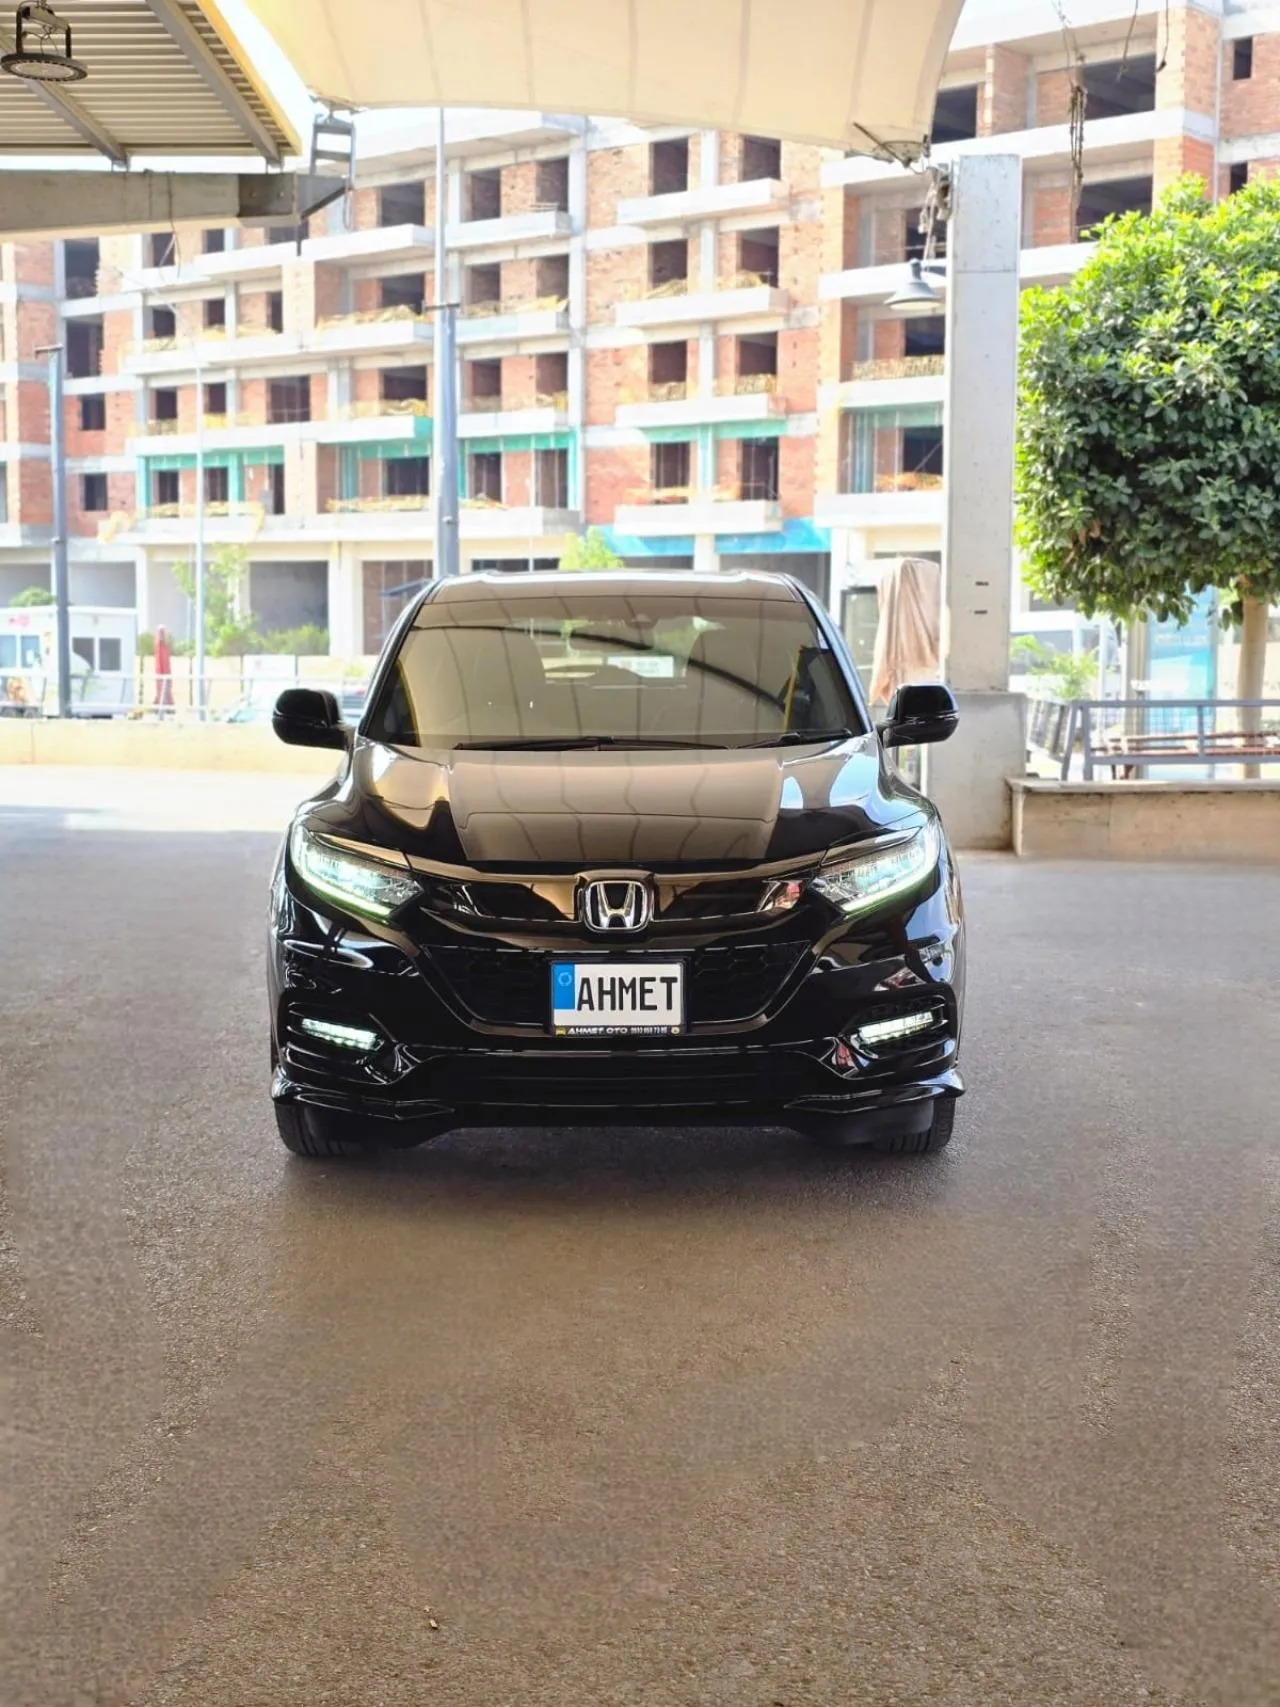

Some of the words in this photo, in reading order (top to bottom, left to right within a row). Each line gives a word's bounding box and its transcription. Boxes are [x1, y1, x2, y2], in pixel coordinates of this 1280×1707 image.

[577, 977, 678, 1011] AHMET
[567, 1027, 604, 1035] AHMET
[606, 1027, 628, 1035] OTO
